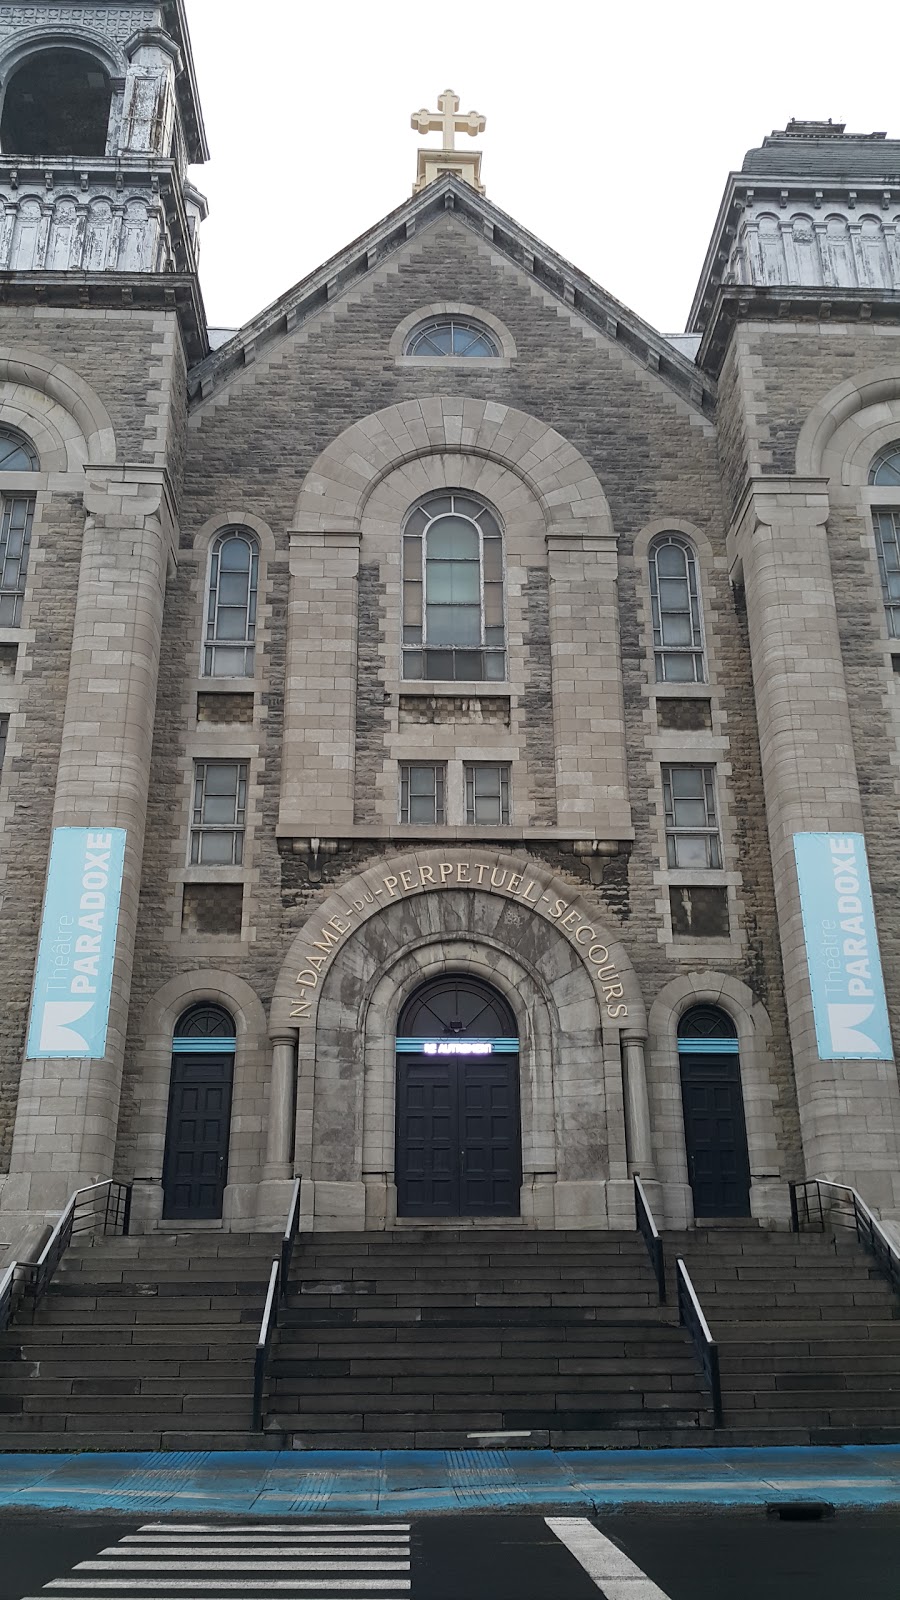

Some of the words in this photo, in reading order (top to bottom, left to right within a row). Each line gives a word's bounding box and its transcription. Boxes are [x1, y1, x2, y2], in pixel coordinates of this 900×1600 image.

[46, 915, 74, 993] Théâtre
[70, 832, 112, 994] PARADOXE
[821, 919, 844, 998] Théâtre
[829, 838, 874, 997] PARADOXE
